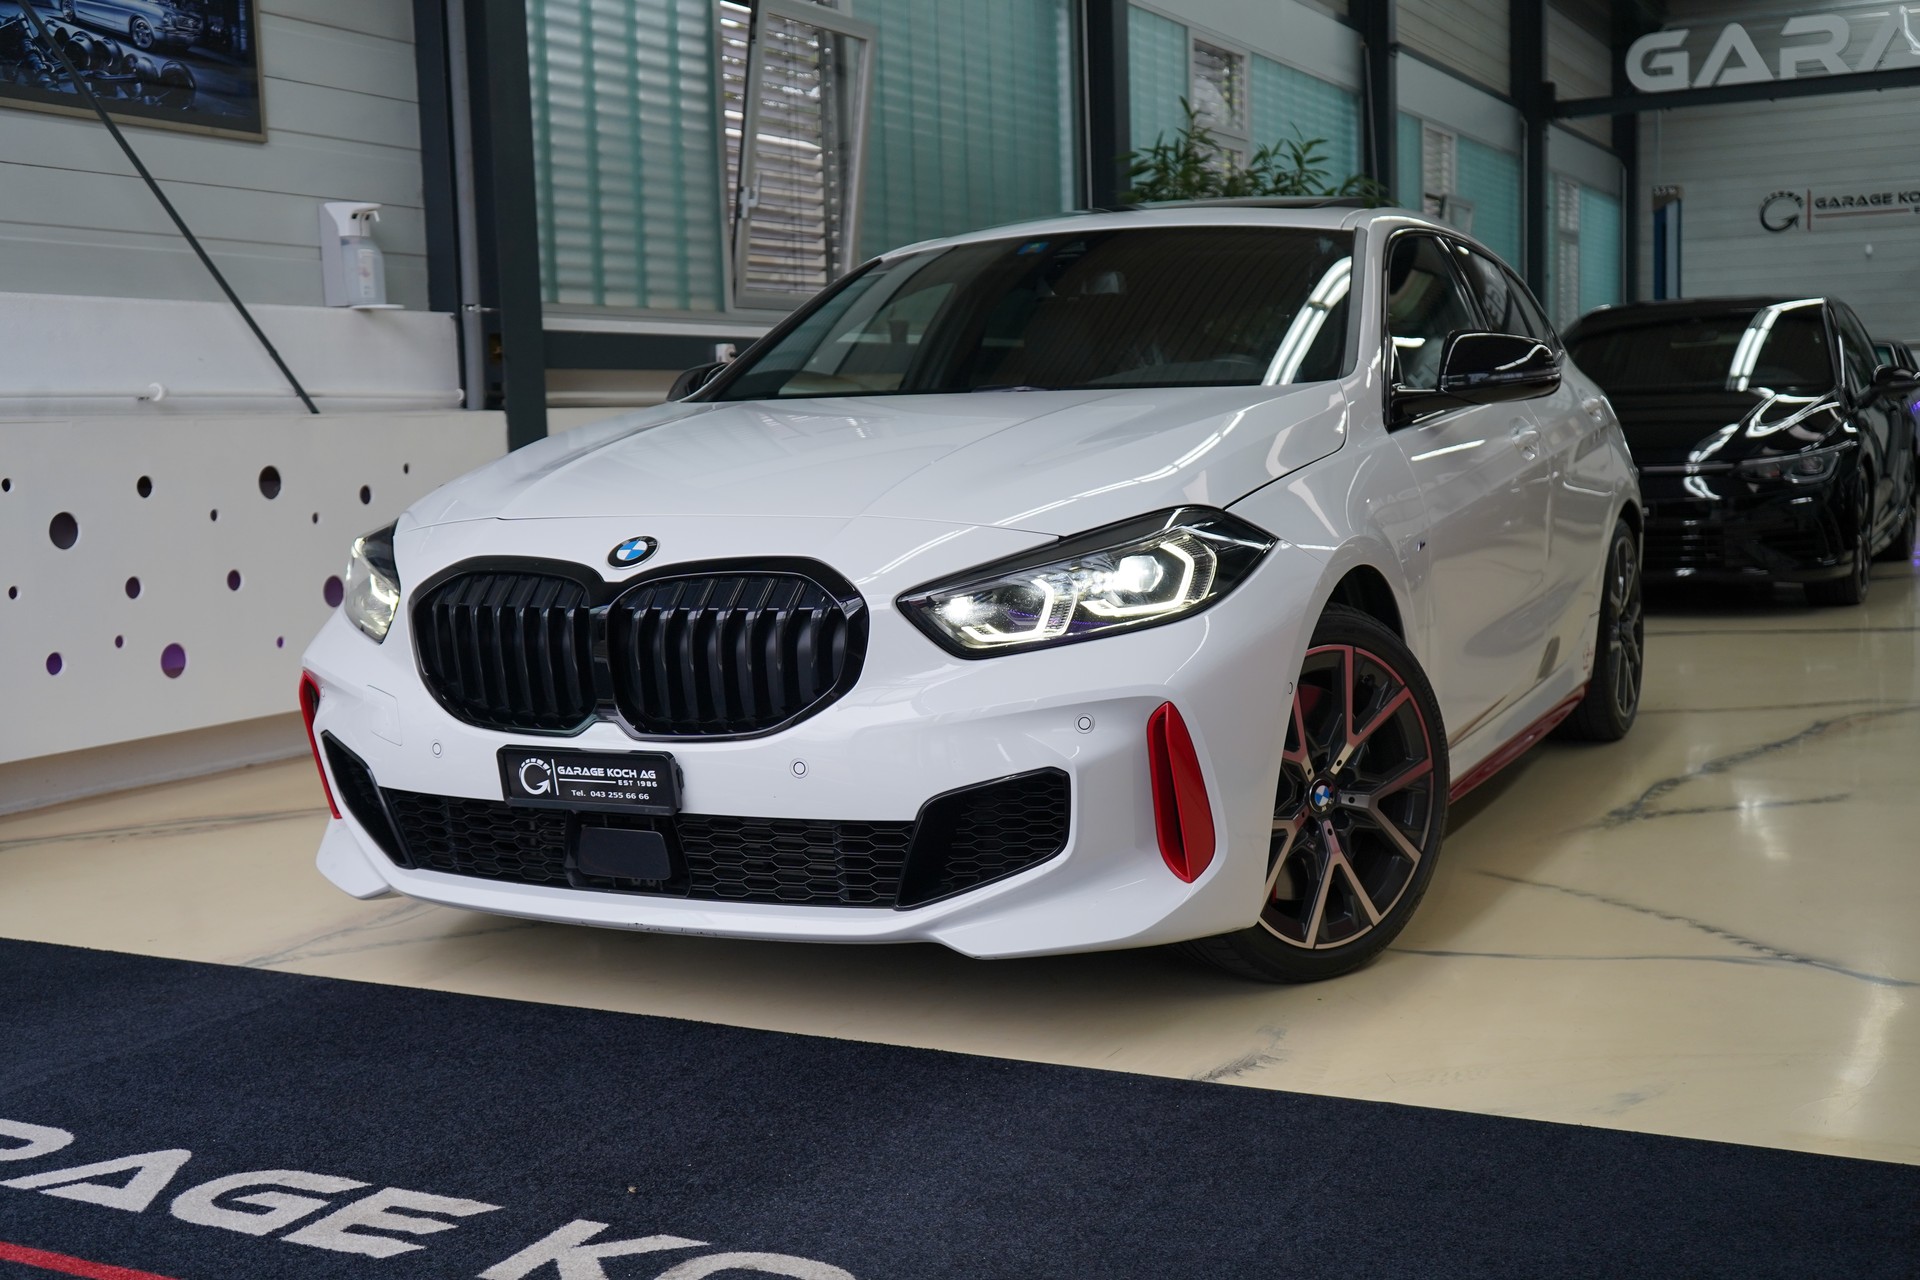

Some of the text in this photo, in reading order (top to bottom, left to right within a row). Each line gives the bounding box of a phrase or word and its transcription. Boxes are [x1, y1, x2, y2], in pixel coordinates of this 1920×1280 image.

[1815, 192, 1893, 209] GARAGE
[557, 766, 656, 779] GARAGE KOCH AG
[617, 779, 658, 788] EST 1986
[571, 789, 586, 797] Tel.
[590, 790, 606, 798] 043
[608, 791, 623, 799] 255
[625, 792, 636, 800] 66
